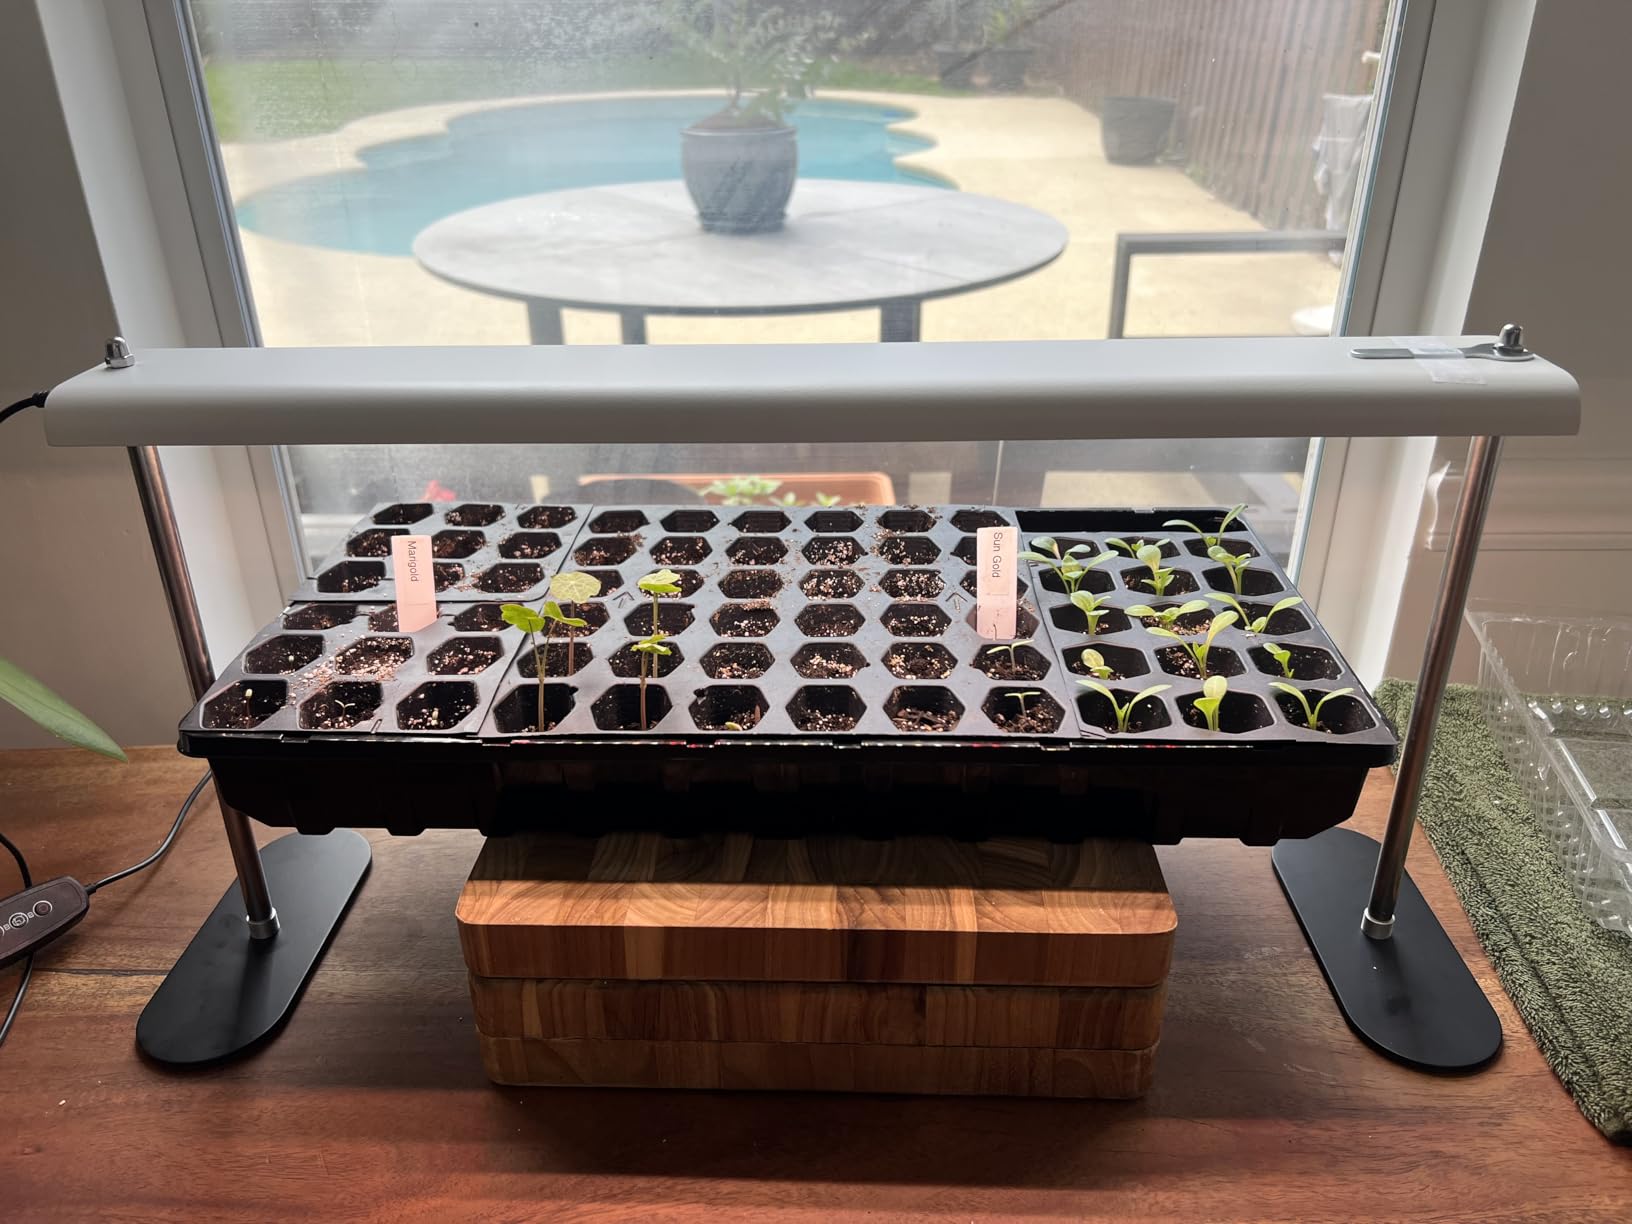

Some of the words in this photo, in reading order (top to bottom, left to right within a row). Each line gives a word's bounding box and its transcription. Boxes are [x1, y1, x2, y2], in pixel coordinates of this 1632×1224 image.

[993, 532, 1003, 552] Sun
[407, 540, 419, 582] Marigold
[991, 555, 1002, 578] Gold
